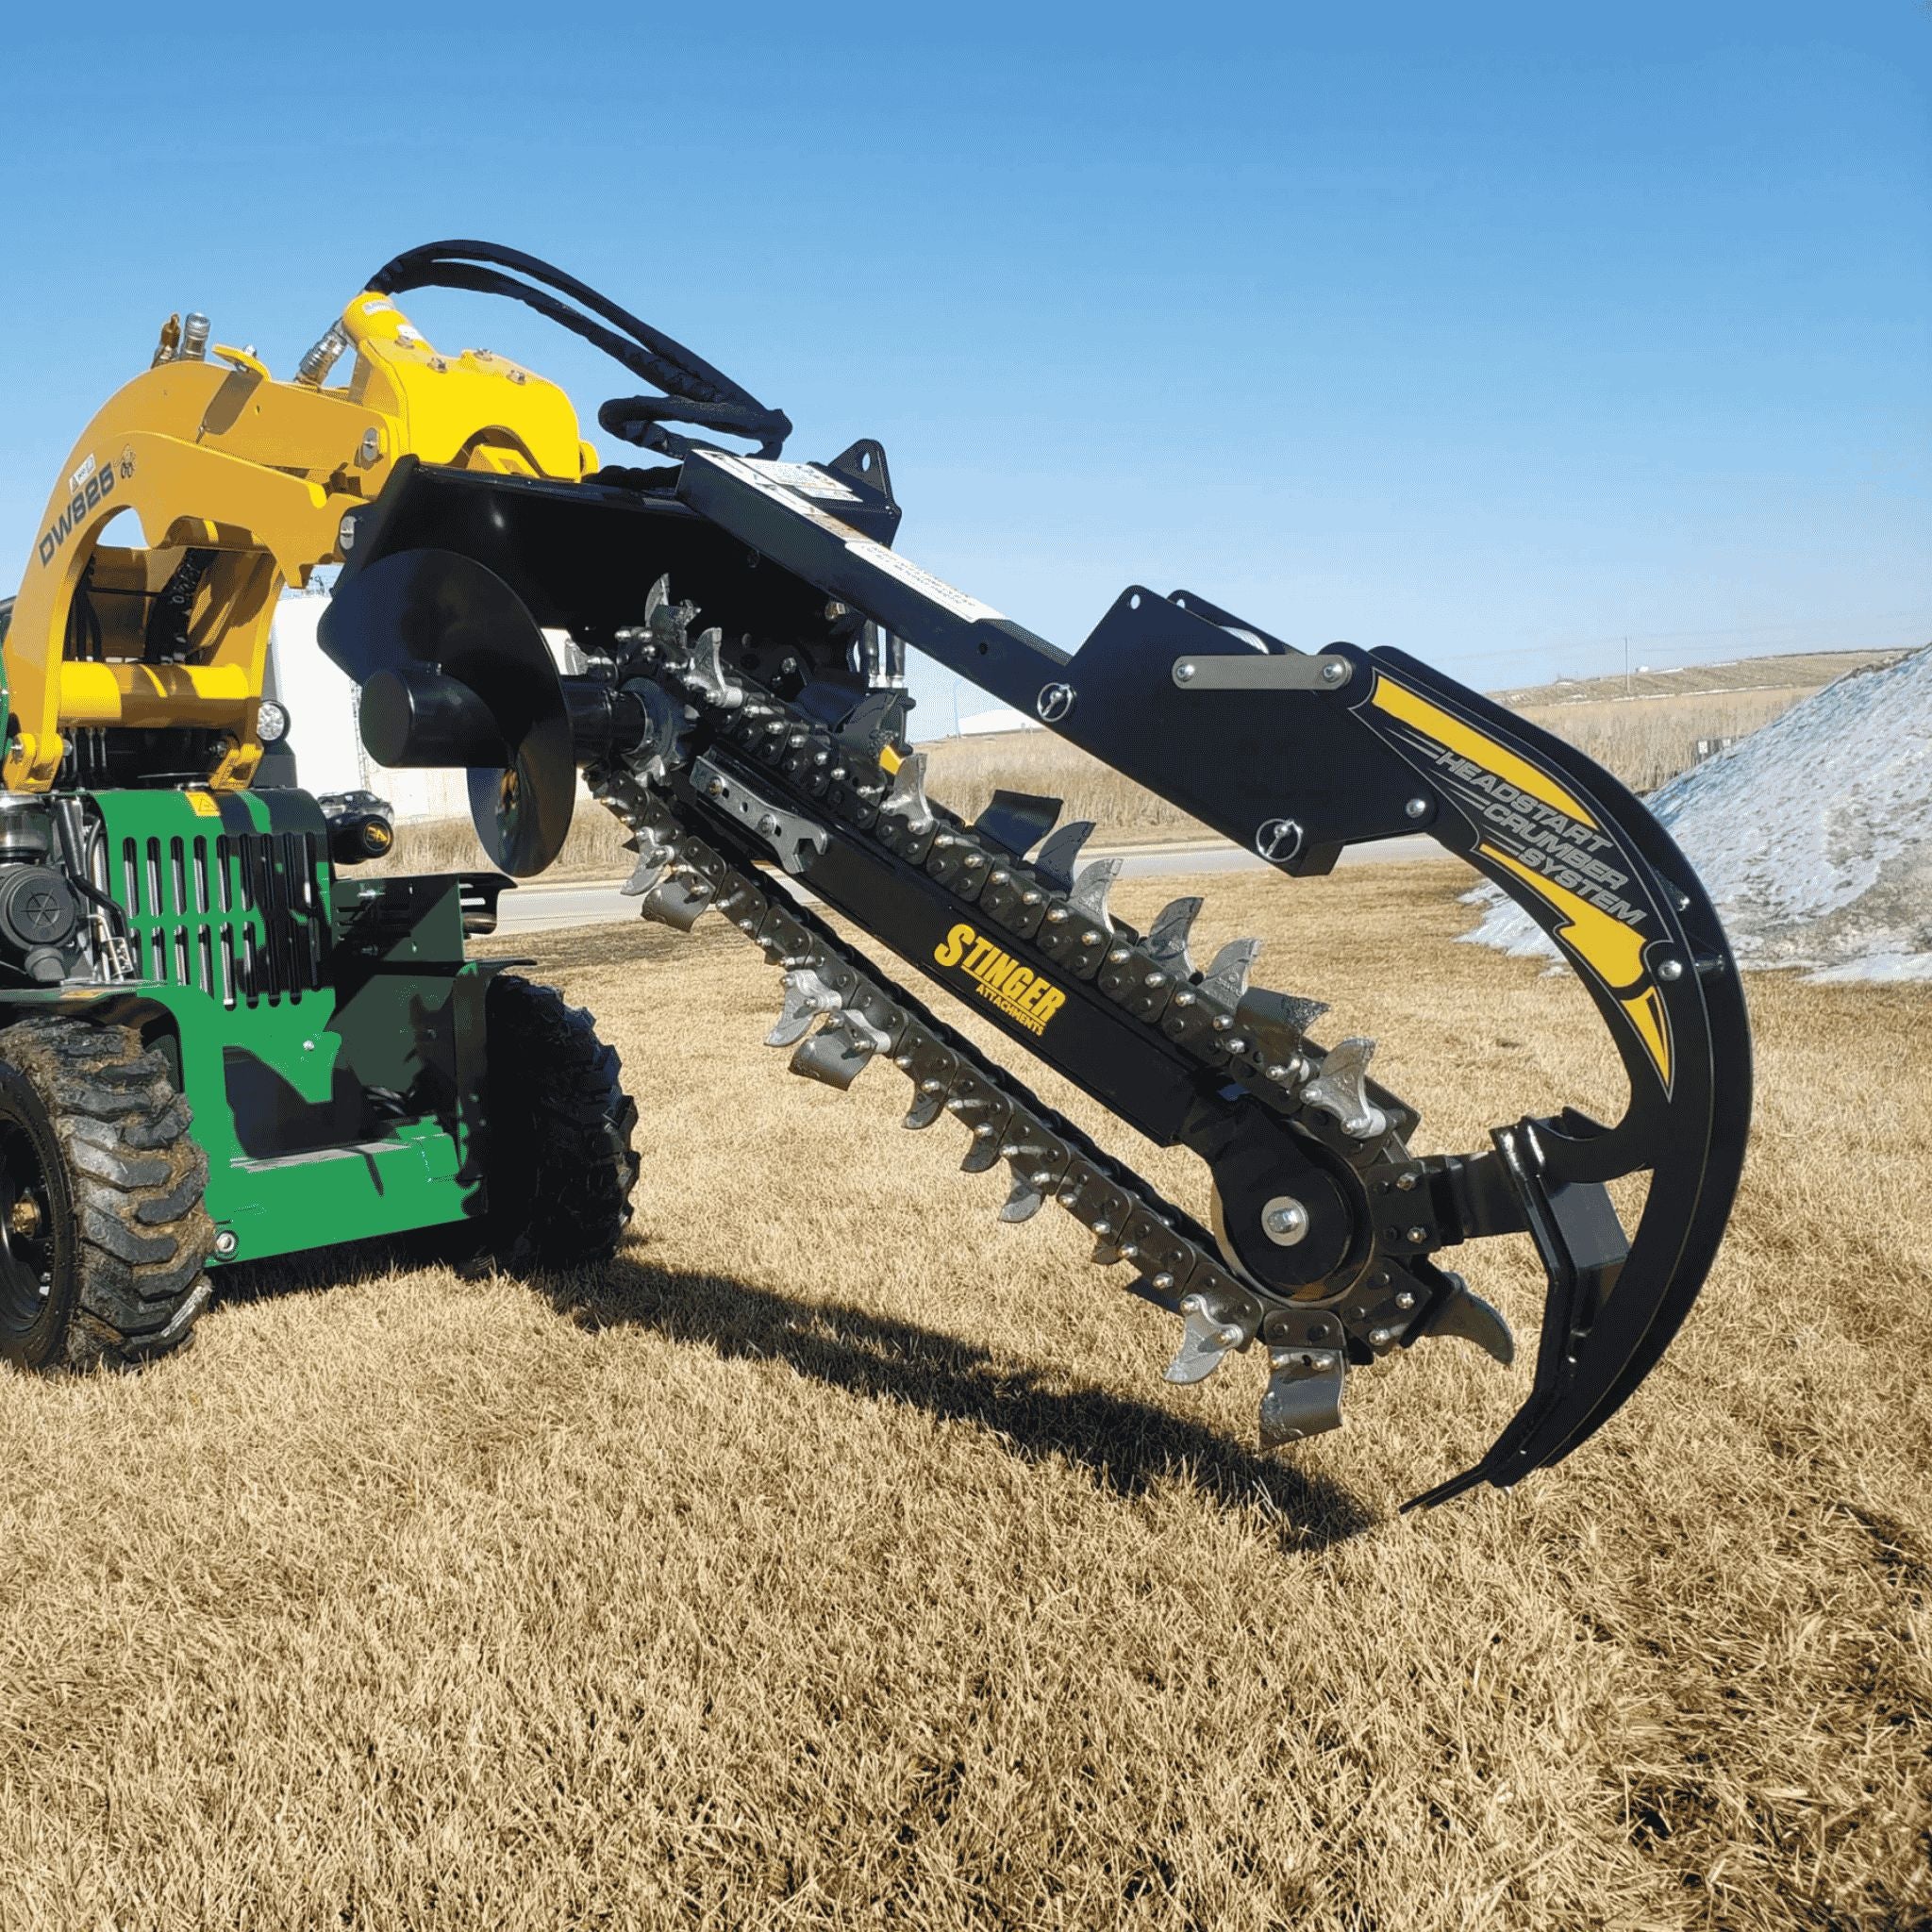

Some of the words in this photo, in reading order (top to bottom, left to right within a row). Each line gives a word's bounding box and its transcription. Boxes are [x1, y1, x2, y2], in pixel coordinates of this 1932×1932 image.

[1437, 752, 1613, 852] HEADSTART
[1483, 803, 1629, 891] CRUMBER
[1518, 848, 1647, 925] SYSTEM
[934, 924, 1066, 1023] STINGER
[975, 985, 1044, 1036] ATTACHMENTS
